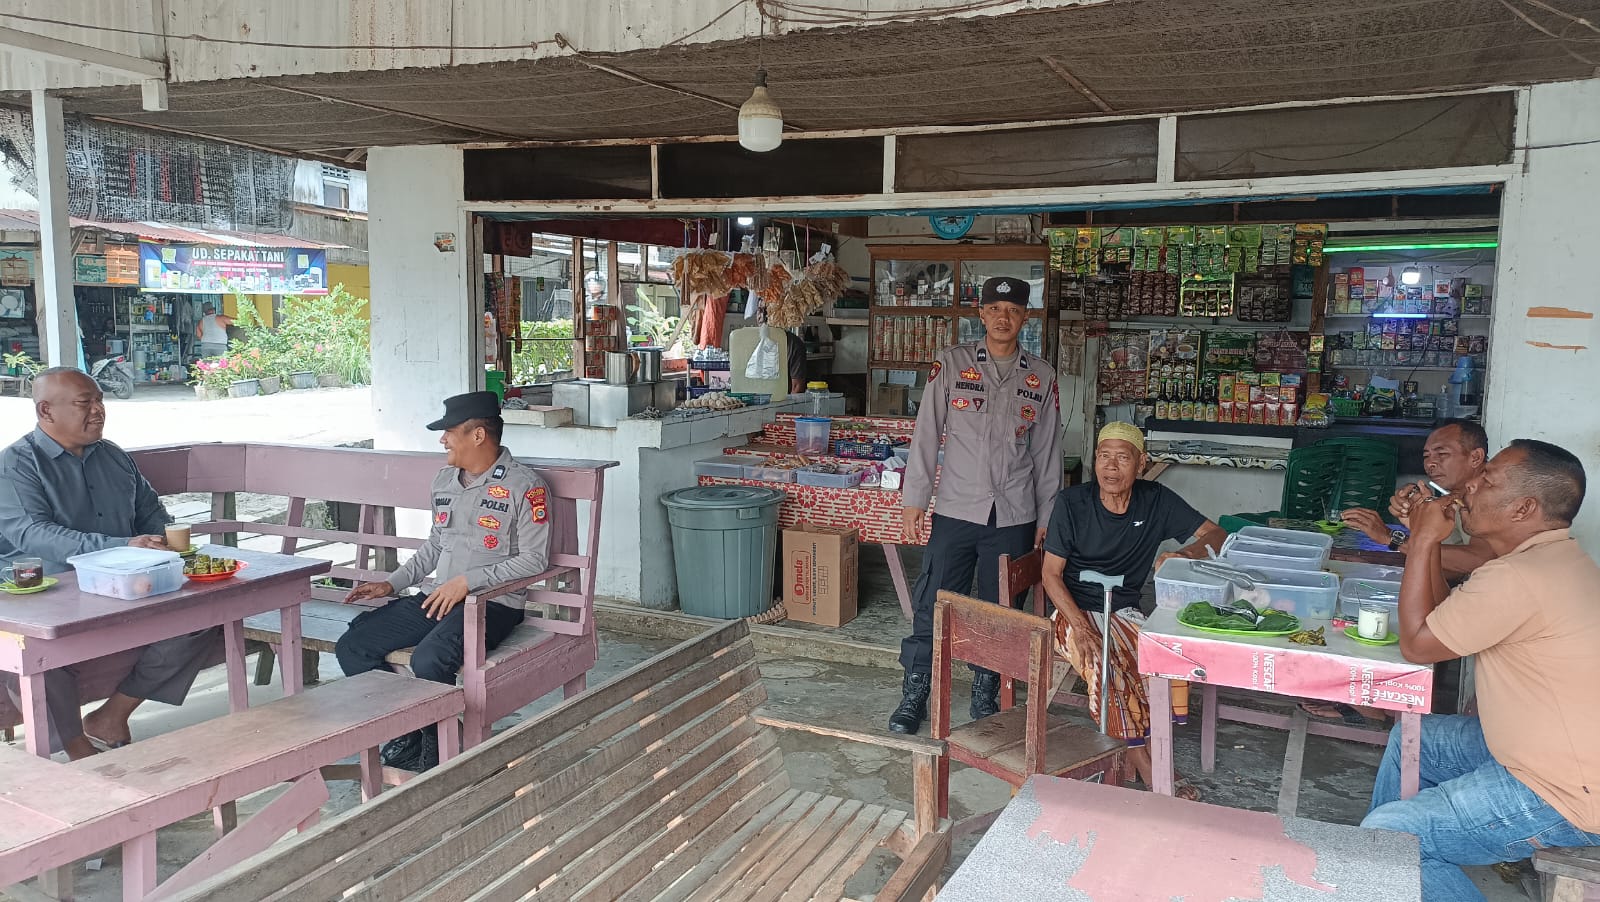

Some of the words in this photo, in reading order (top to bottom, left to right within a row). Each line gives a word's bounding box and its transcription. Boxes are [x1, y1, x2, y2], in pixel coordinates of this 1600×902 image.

[192, 247, 211, 260] UD.
[213, 248, 259, 262] SEPAKAT
[261, 251, 284, 262] TANI
[955, 381, 985, 392] HENDRA
[1017, 389, 1043, 402] POLRI
[479, 499, 509, 513] POLRI
[1263, 653, 1275, 692] NESCAF
[1404, 683, 1426, 692] 100%
